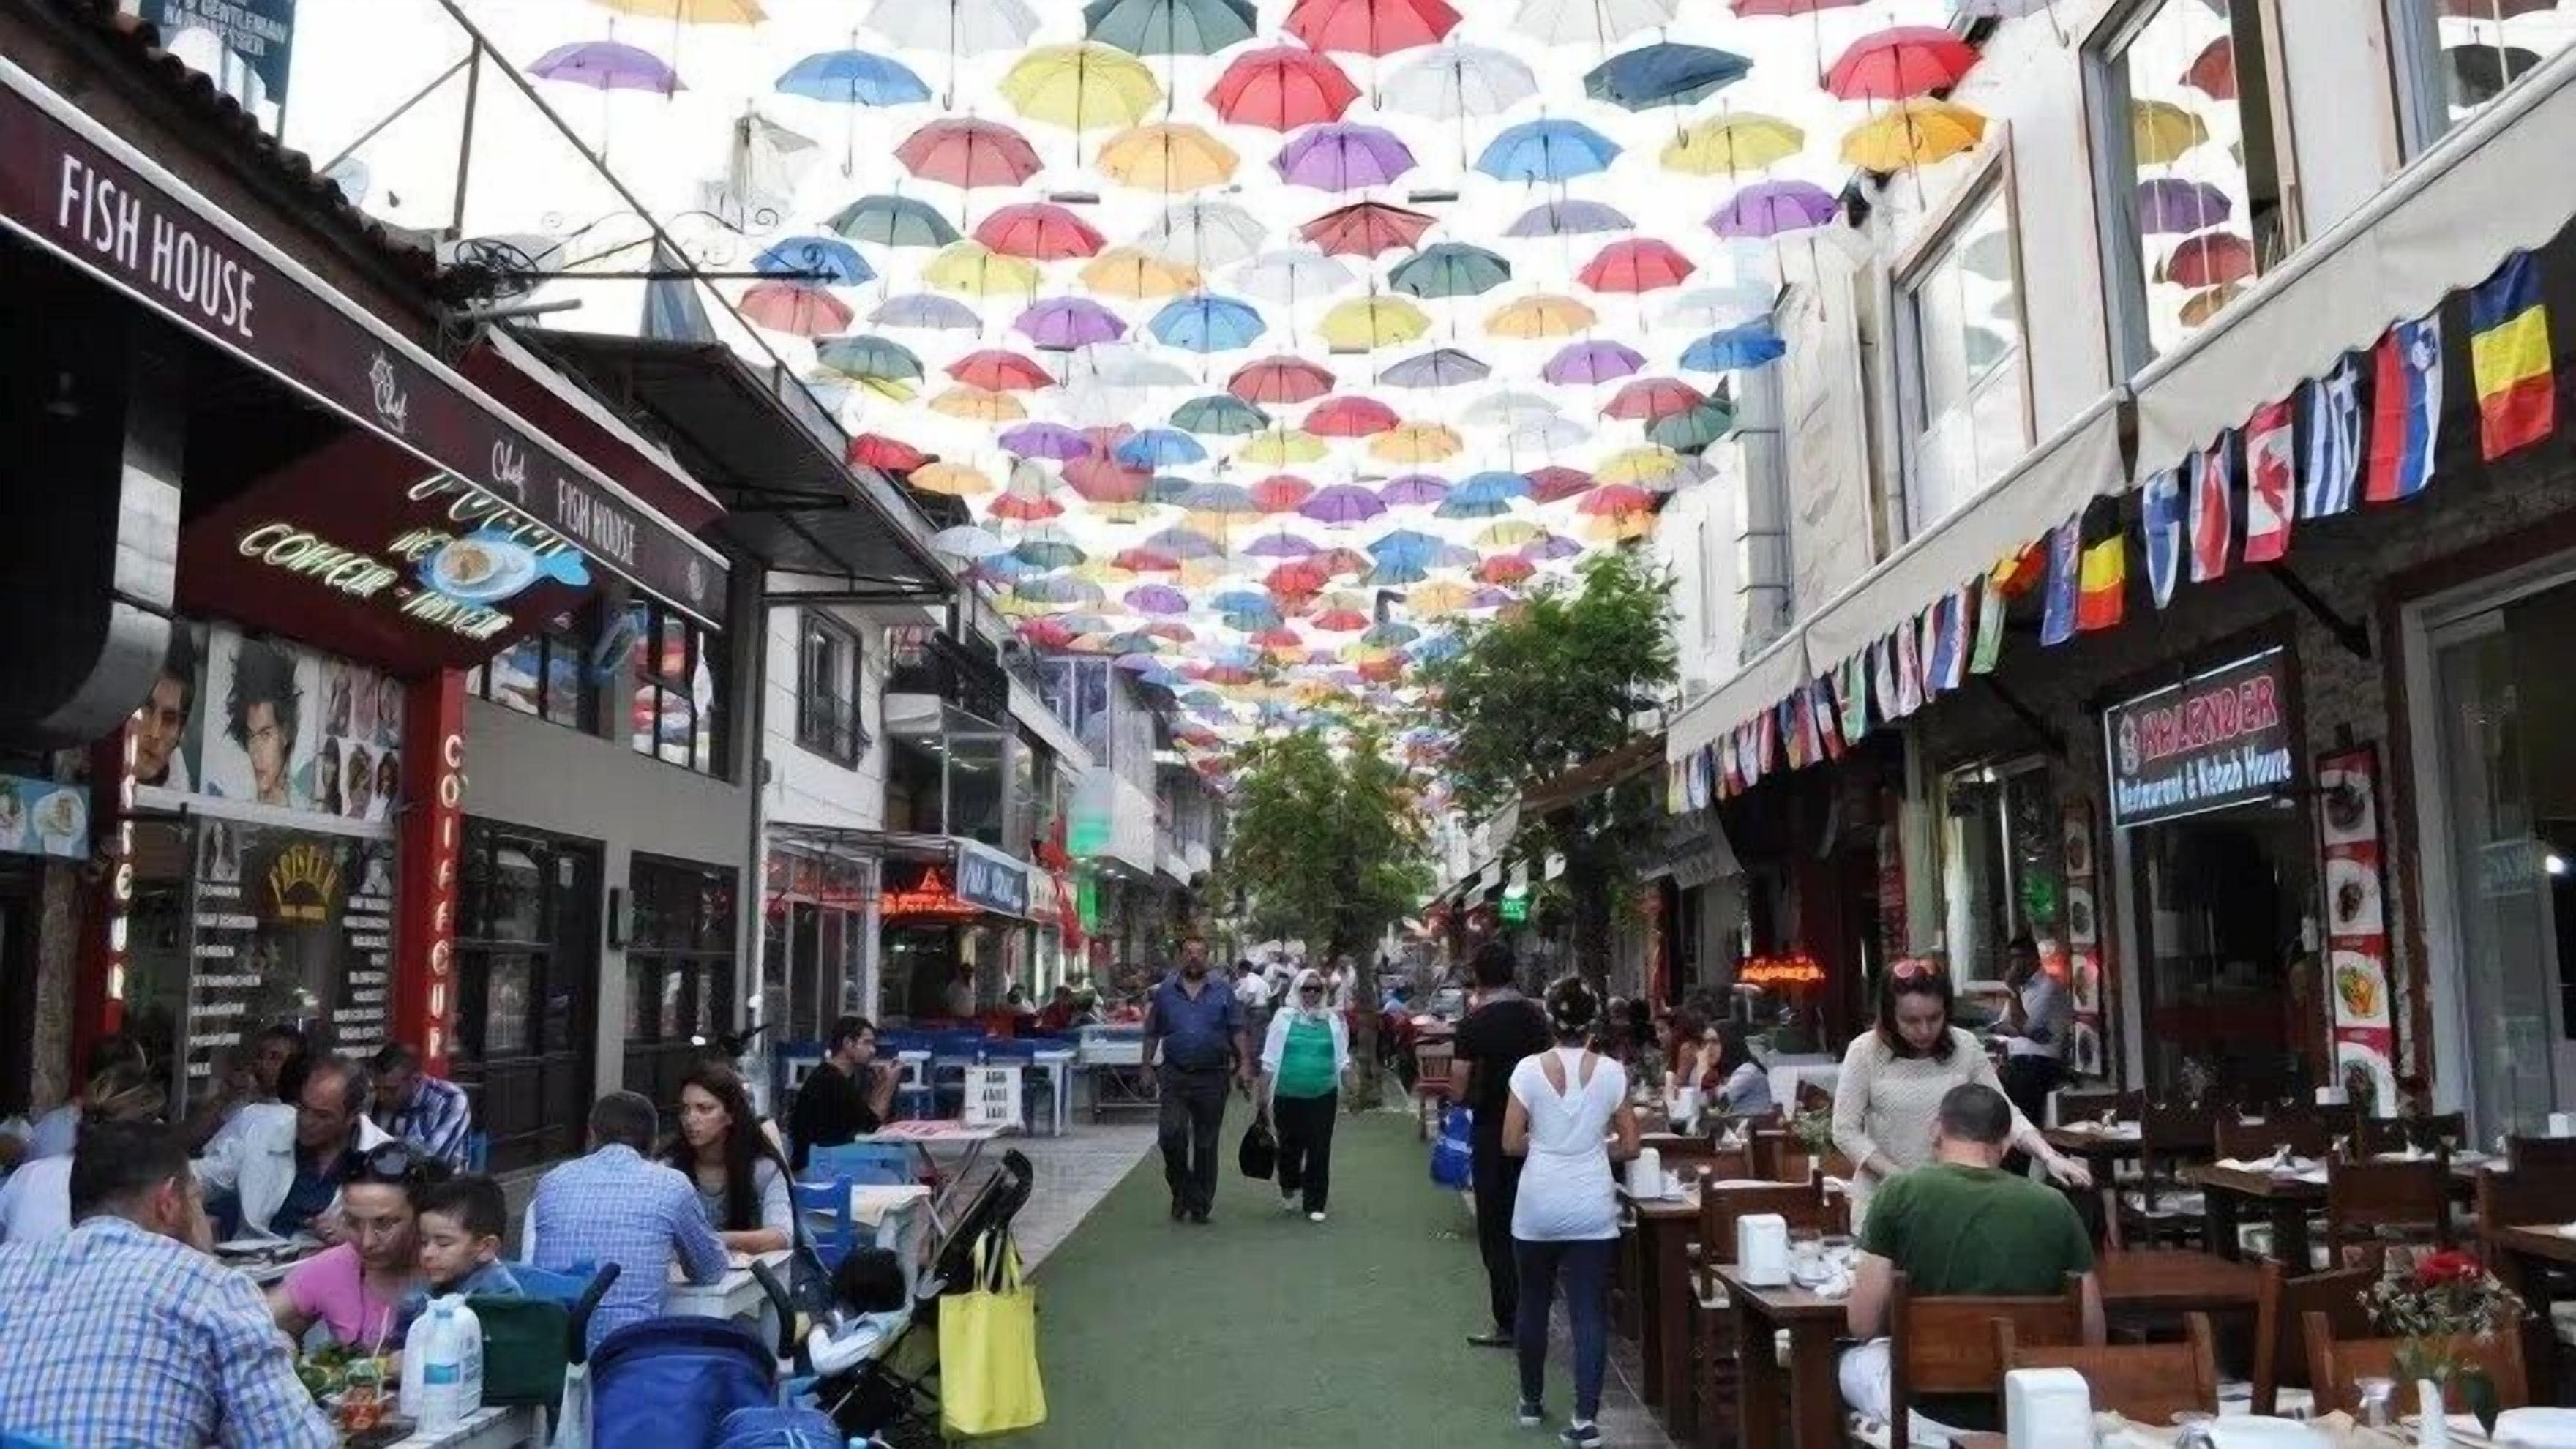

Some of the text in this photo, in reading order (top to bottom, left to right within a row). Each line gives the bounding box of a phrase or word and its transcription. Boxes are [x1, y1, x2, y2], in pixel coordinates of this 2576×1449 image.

[59, 153, 255, 337] FISH HOUSE
[429, 733, 464, 1059] COIFFEUR
